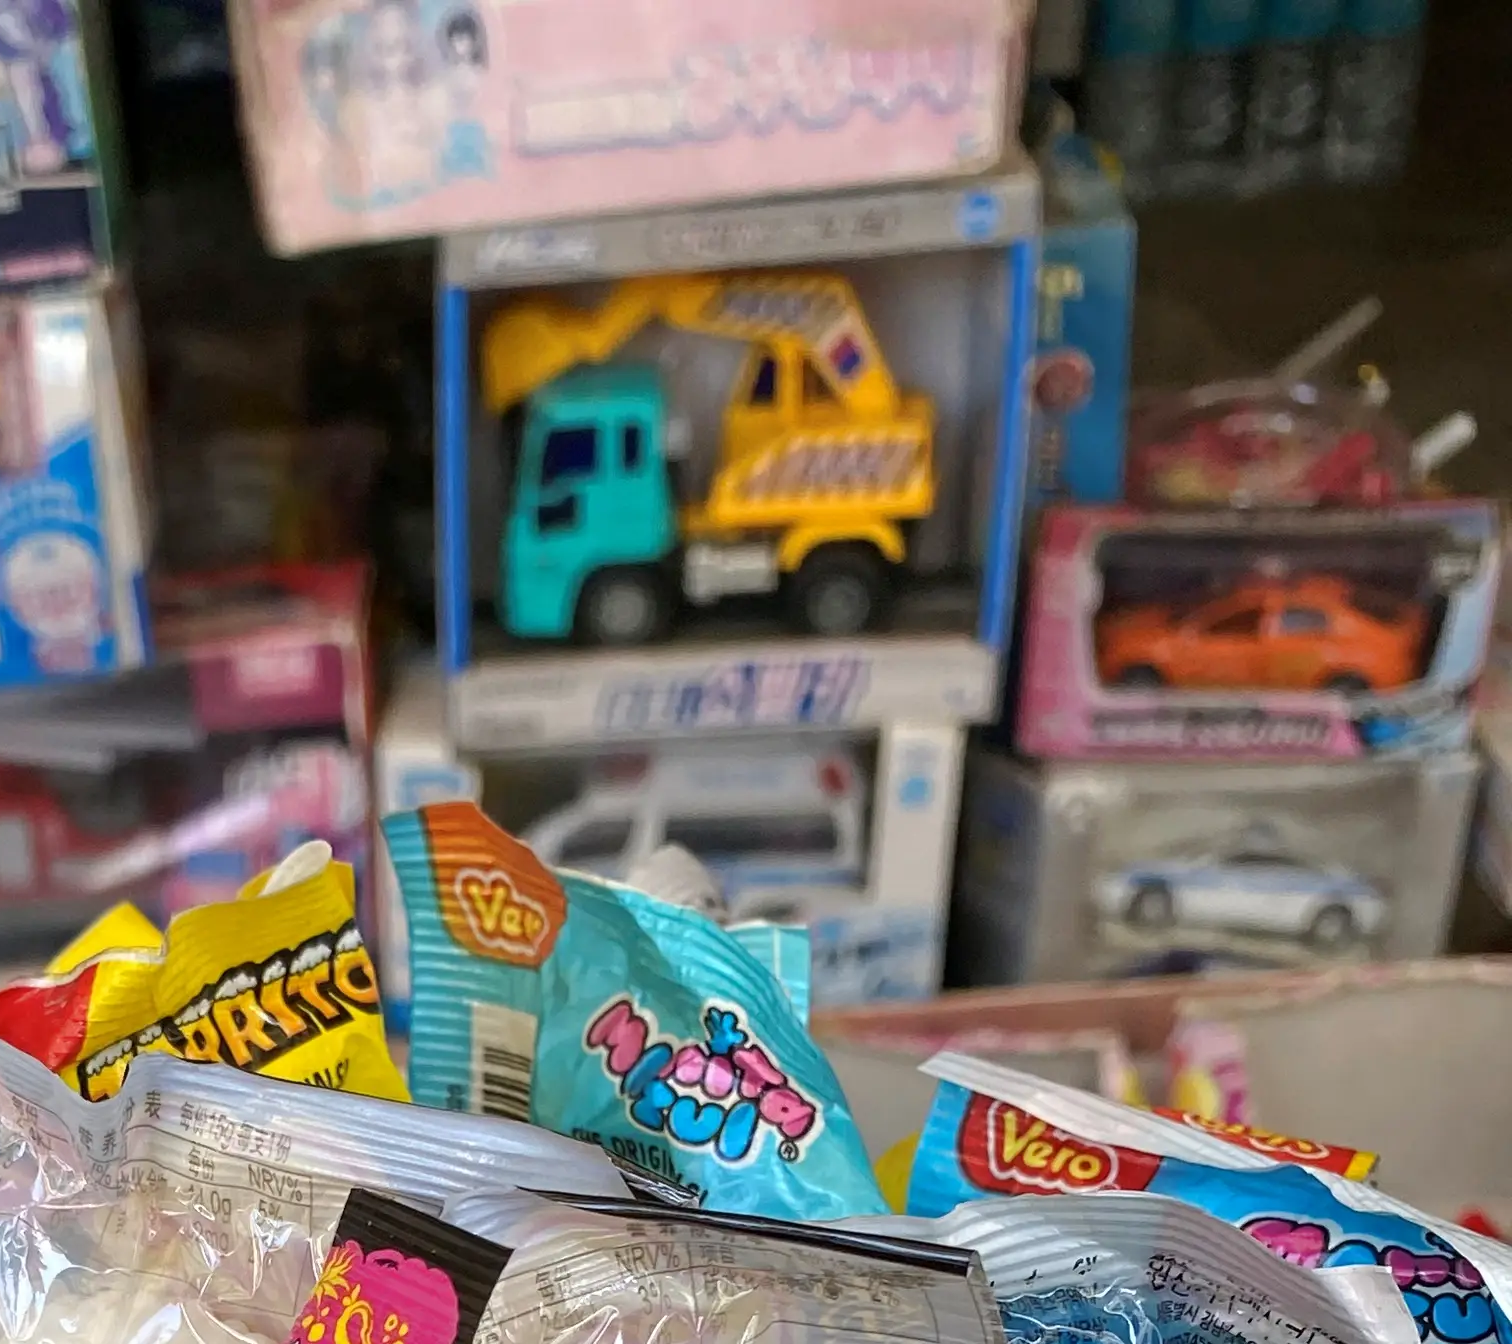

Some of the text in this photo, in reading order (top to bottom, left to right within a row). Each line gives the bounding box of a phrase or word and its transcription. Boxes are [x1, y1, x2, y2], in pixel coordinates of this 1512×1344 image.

[1001, 1109, 1102, 1181] Vero
[247, 1164, 304, 1203] NRV%
[614, 1243, 682, 1273] NRV%
